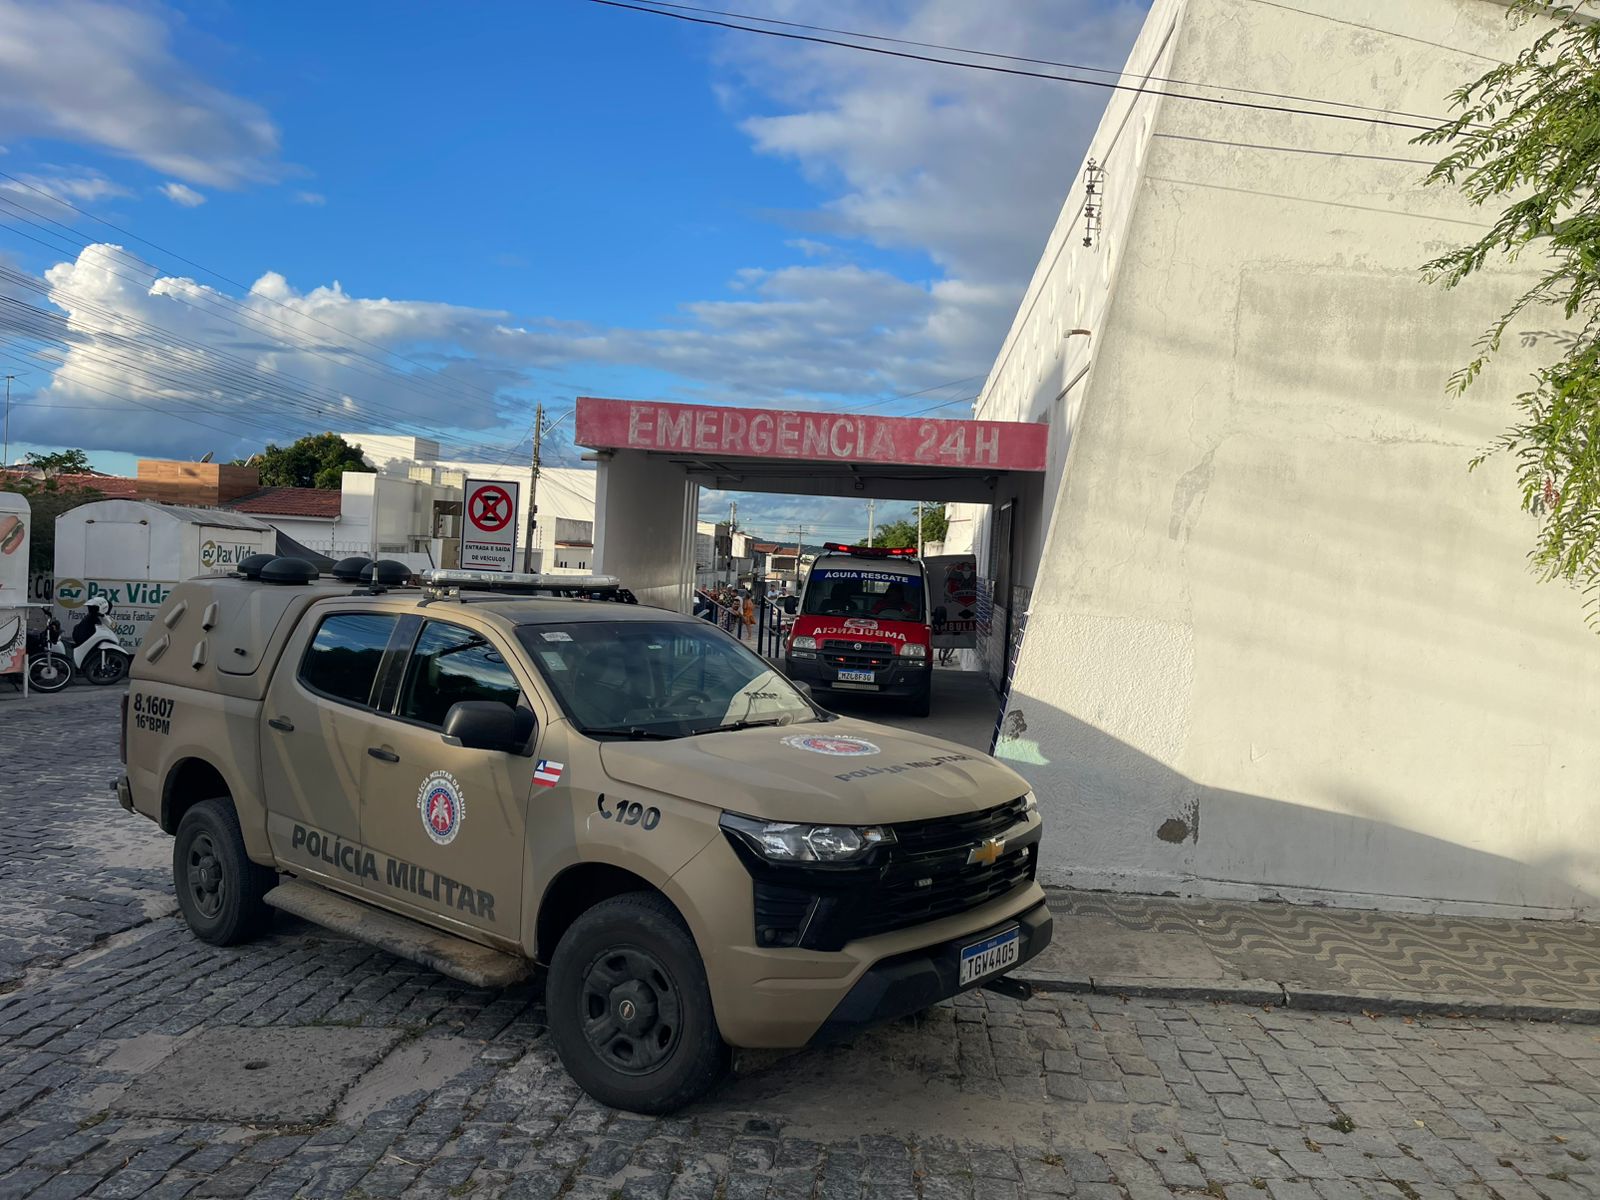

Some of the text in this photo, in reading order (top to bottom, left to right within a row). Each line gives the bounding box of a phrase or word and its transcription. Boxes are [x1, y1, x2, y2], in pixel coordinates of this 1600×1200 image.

[628, 405, 1000, 464] EMERGÊNCIA 24H
[217, 545, 232, 563] Pax
[861, 573, 908, 583] RESGATE
[88, 582, 120, 603] Pax
[134, 692, 174, 718] 8.1607
[429, 769, 453, 782] MILITAR
[451, 779, 460, 791] DA
[615, 799, 661, 831] 190
[292, 824, 496, 922] POLÍCIA MILITAR
[967, 941, 1014, 979] TGW4A05
